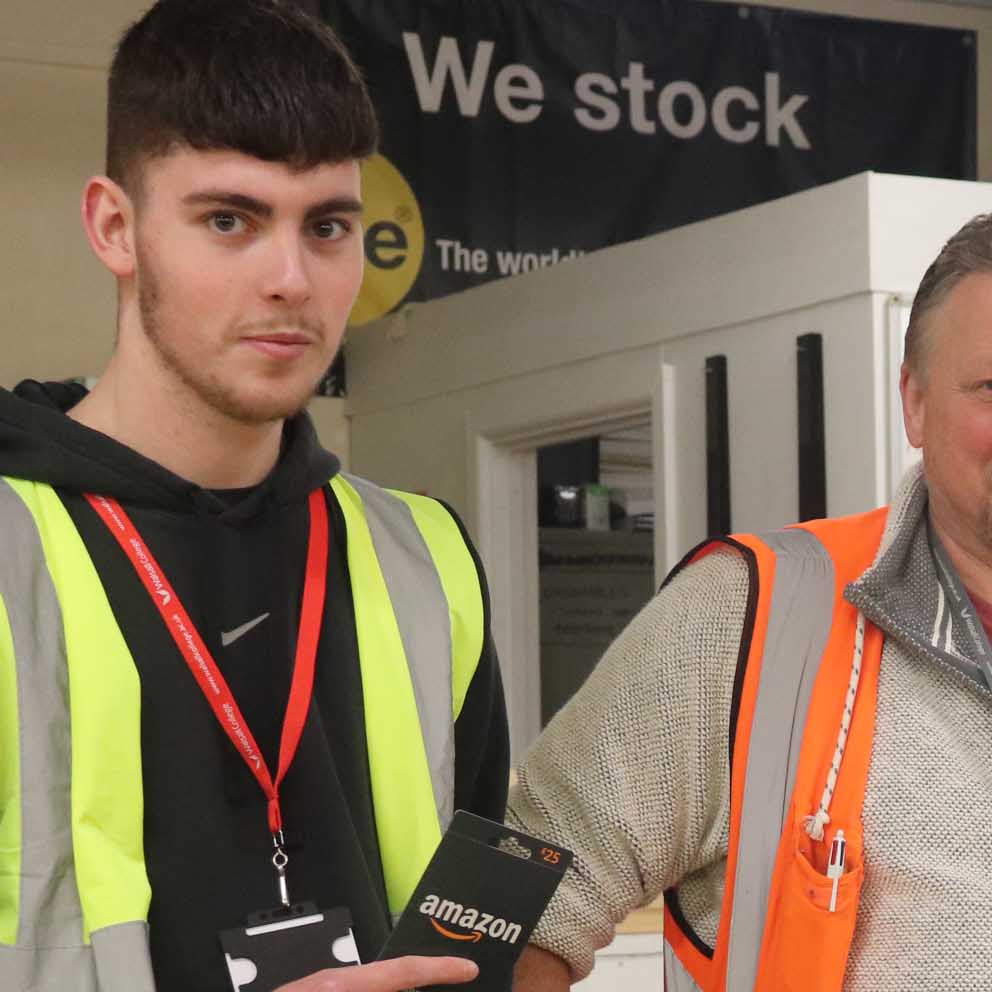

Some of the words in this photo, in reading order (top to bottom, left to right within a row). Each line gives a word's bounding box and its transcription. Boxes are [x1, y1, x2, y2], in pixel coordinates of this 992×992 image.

[402, 31, 545, 123] We
[574, 61, 812, 150] stock
[435, 239, 488, 274] The
[540, 847, 561, 864] £25
[419, 894, 522, 944] amazon
